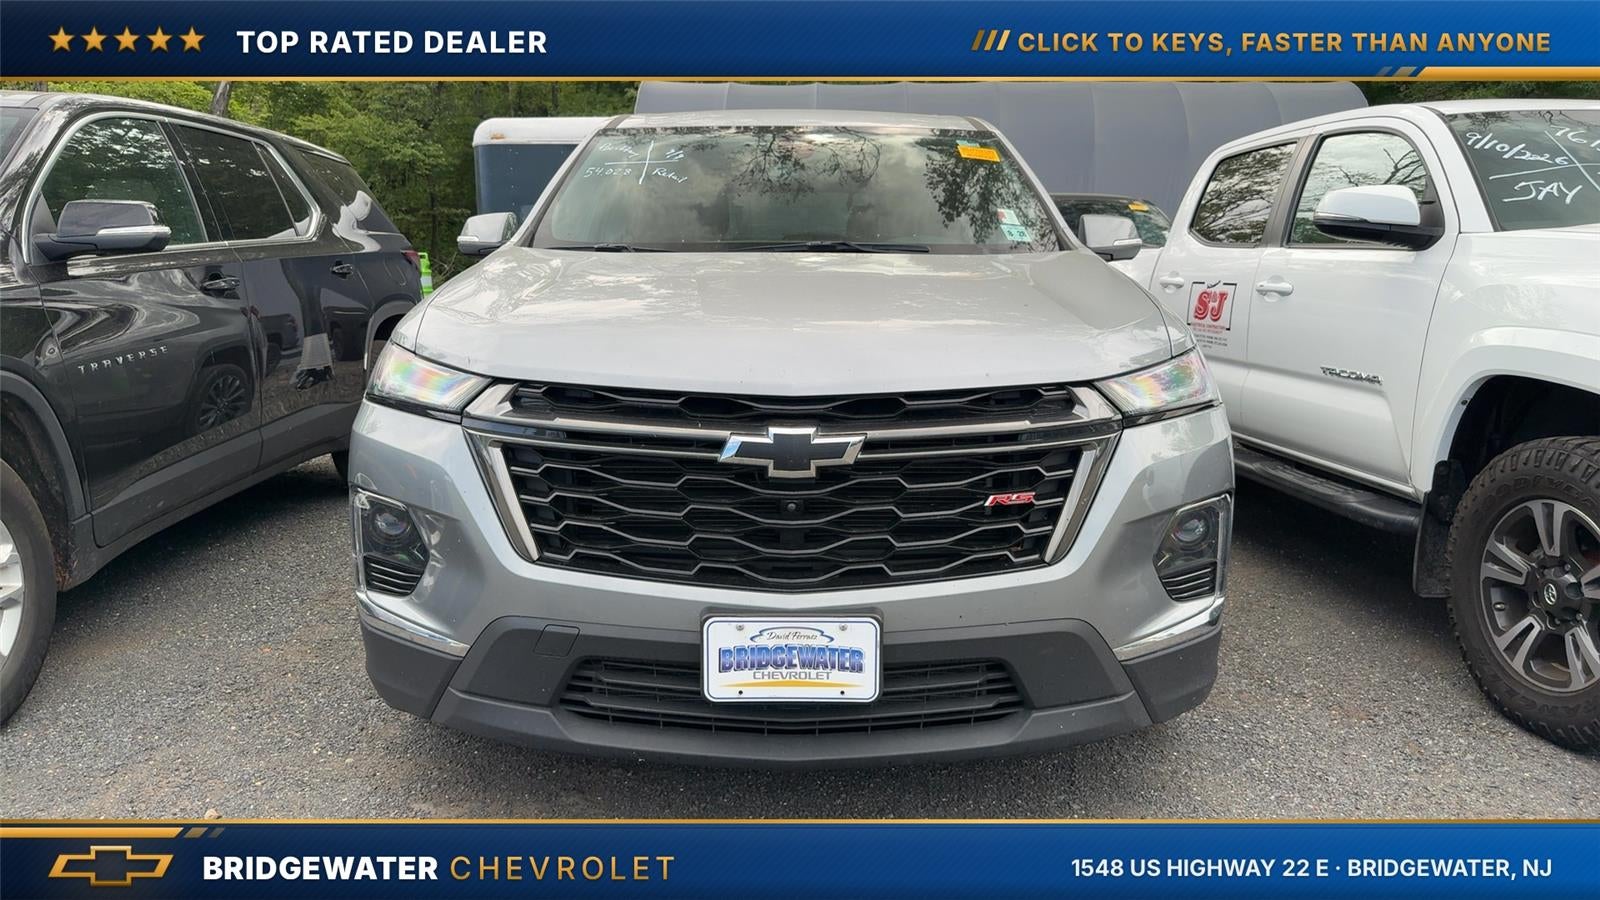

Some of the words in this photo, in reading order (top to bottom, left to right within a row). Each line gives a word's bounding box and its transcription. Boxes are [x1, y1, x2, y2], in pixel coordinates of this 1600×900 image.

[1502, 180, 1583, 204] JAY
[78, 345, 168, 374] TRAVERSE
[1319, 366, 1383, 386] TACOMA
[984, 491, 1036, 507] RS
[766, 631, 791, 641] David
[718, 643, 864, 673] BRIDGEWATER
[753, 671, 832, 680] CHEVROLET
